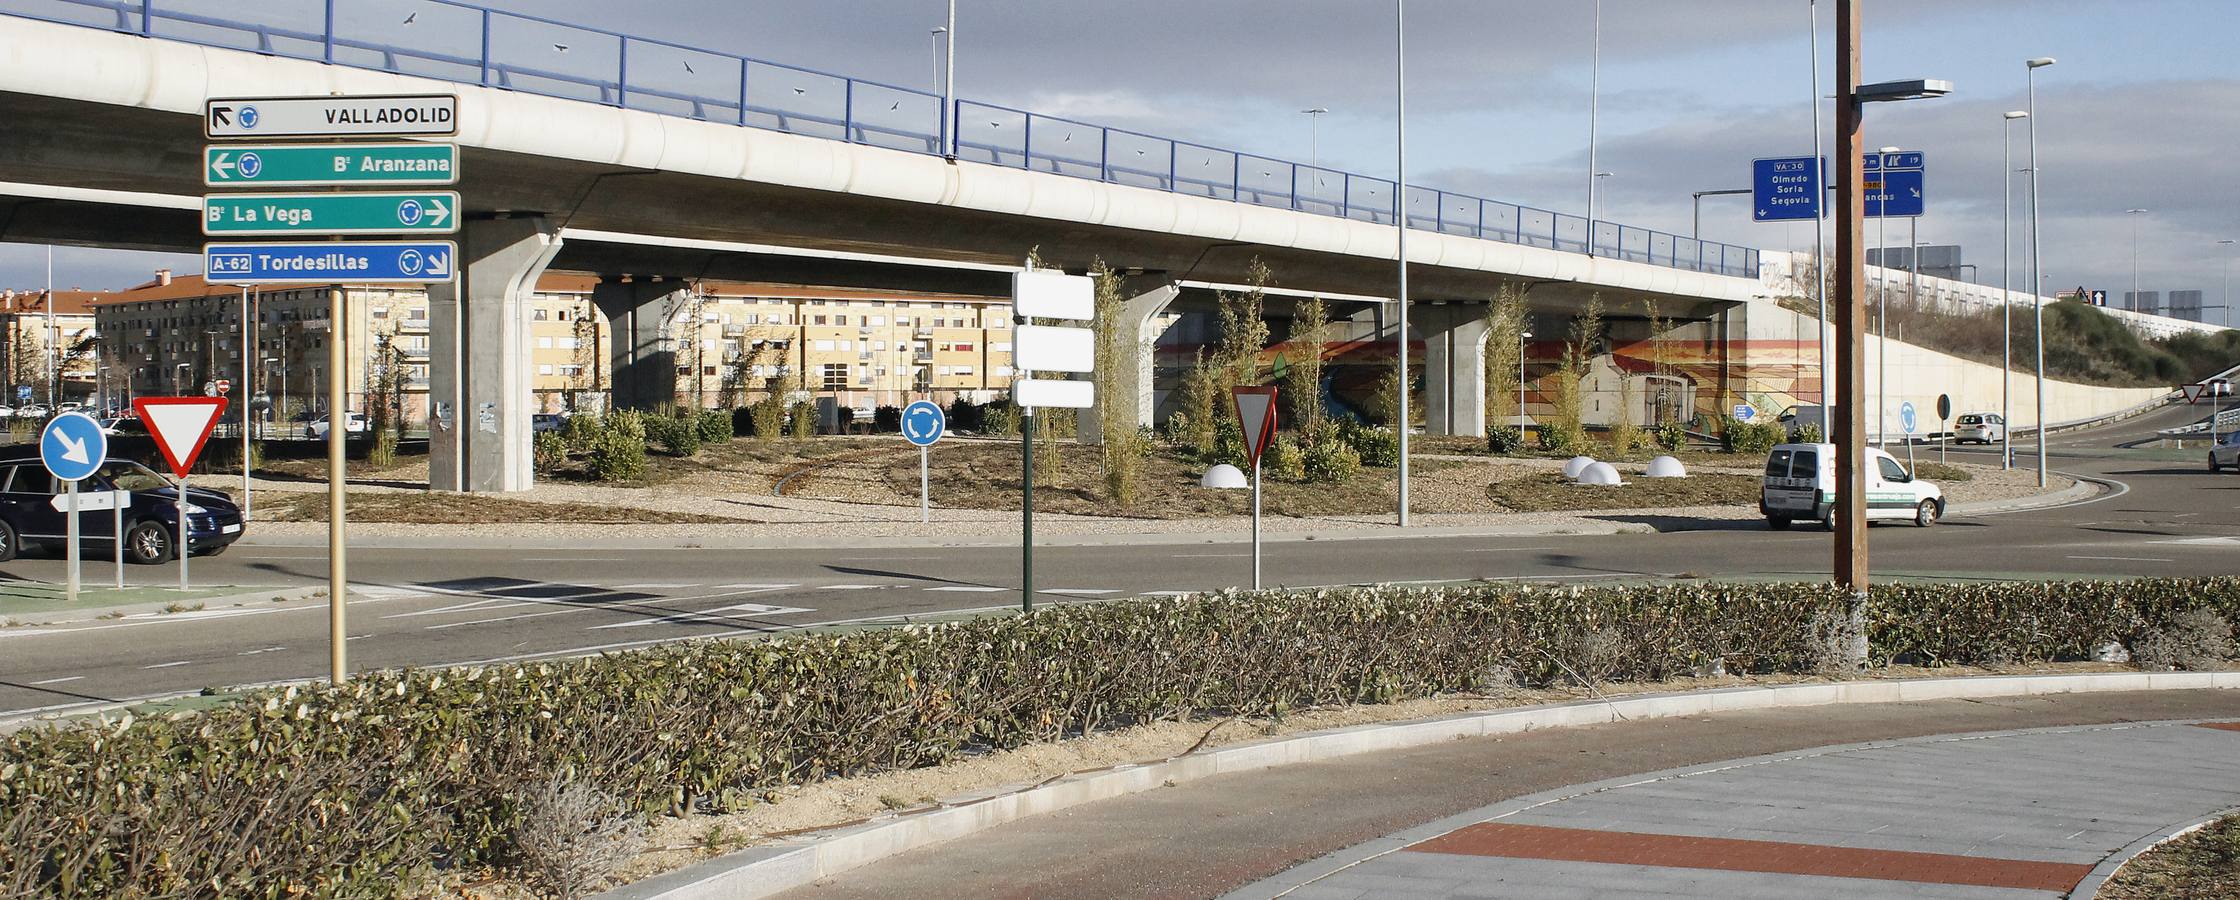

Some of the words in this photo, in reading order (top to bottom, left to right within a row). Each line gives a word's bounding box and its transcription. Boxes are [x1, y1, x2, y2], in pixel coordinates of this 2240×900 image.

[325, 107, 451, 124] VALLADOLID
[361, 156, 450, 172] Aranzana
[1772, 176, 1808, 184] Olmedo
[1777, 186, 1803, 194] Soria
[1771, 196, 1810, 207] Segovia
[234, 206, 257, 222] La
[264, 206, 313, 225] Vega
[213, 257, 250, 270] A-62
[259, 254, 369, 271] Tordesillas
